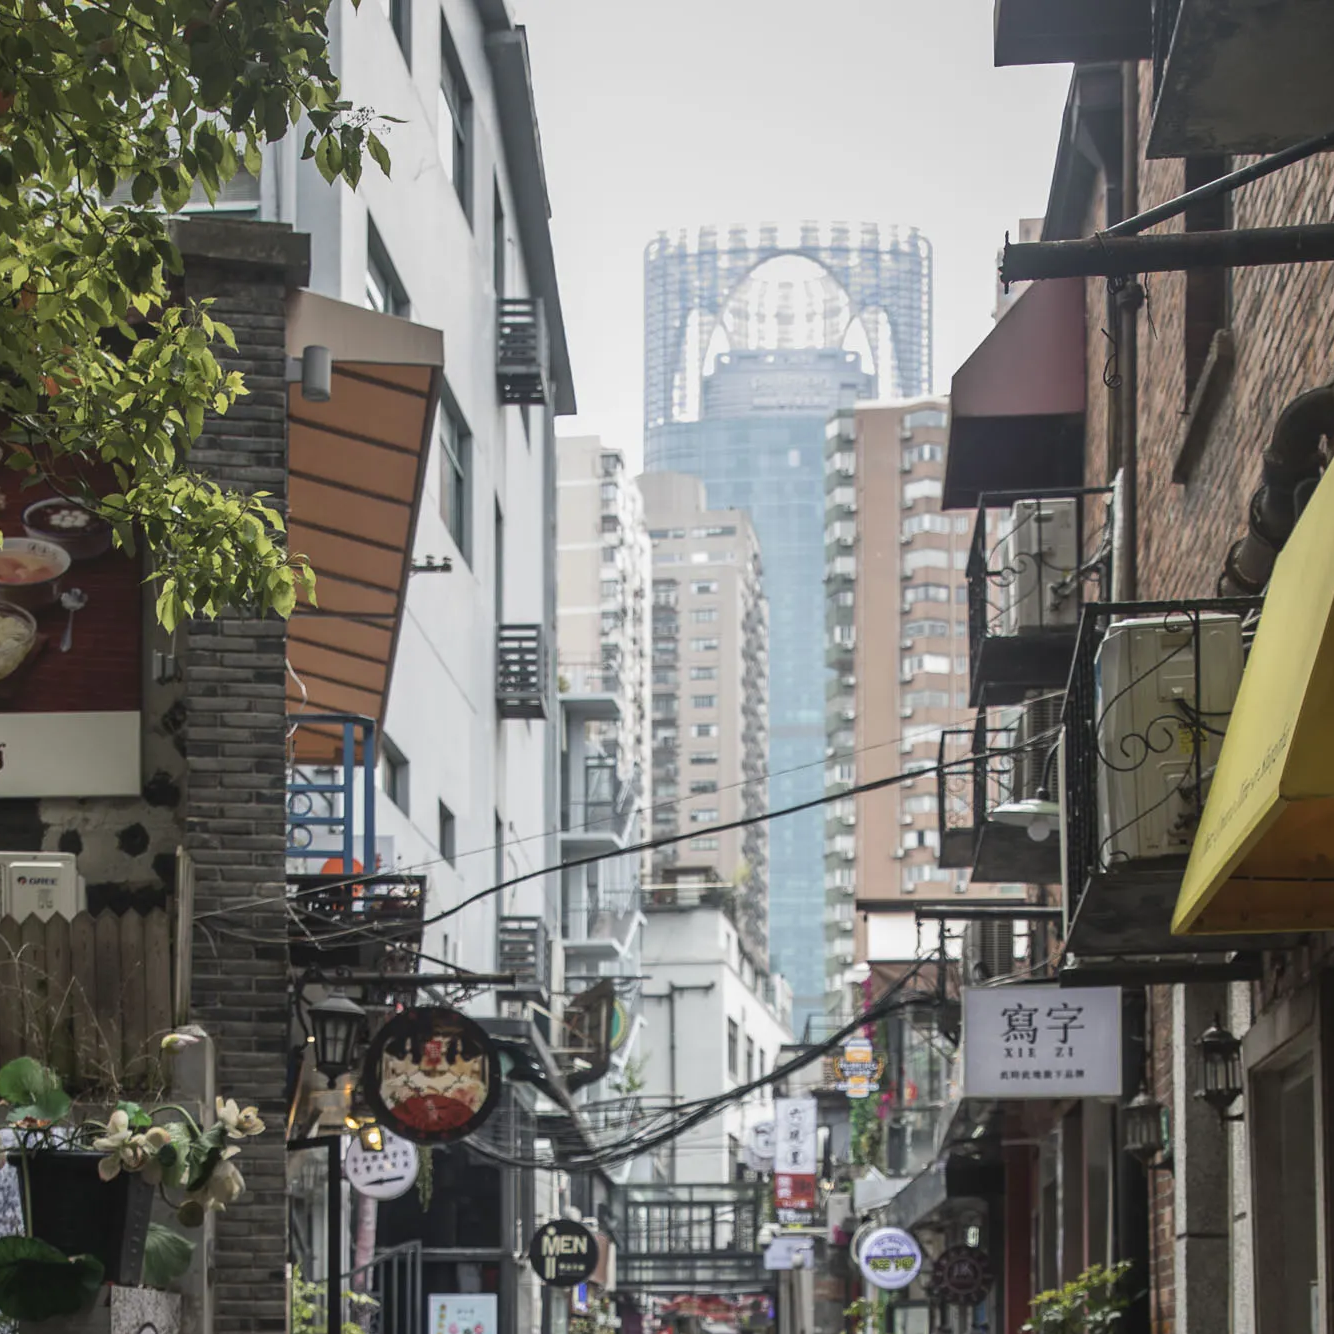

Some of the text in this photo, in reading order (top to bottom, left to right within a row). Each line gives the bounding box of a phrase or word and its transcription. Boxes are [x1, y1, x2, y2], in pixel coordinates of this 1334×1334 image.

[28, 876, 58, 886] GREE
[999, 1002, 1086, 1046] 寫字
[1003, 1047, 1075, 1059] XIE ZI
